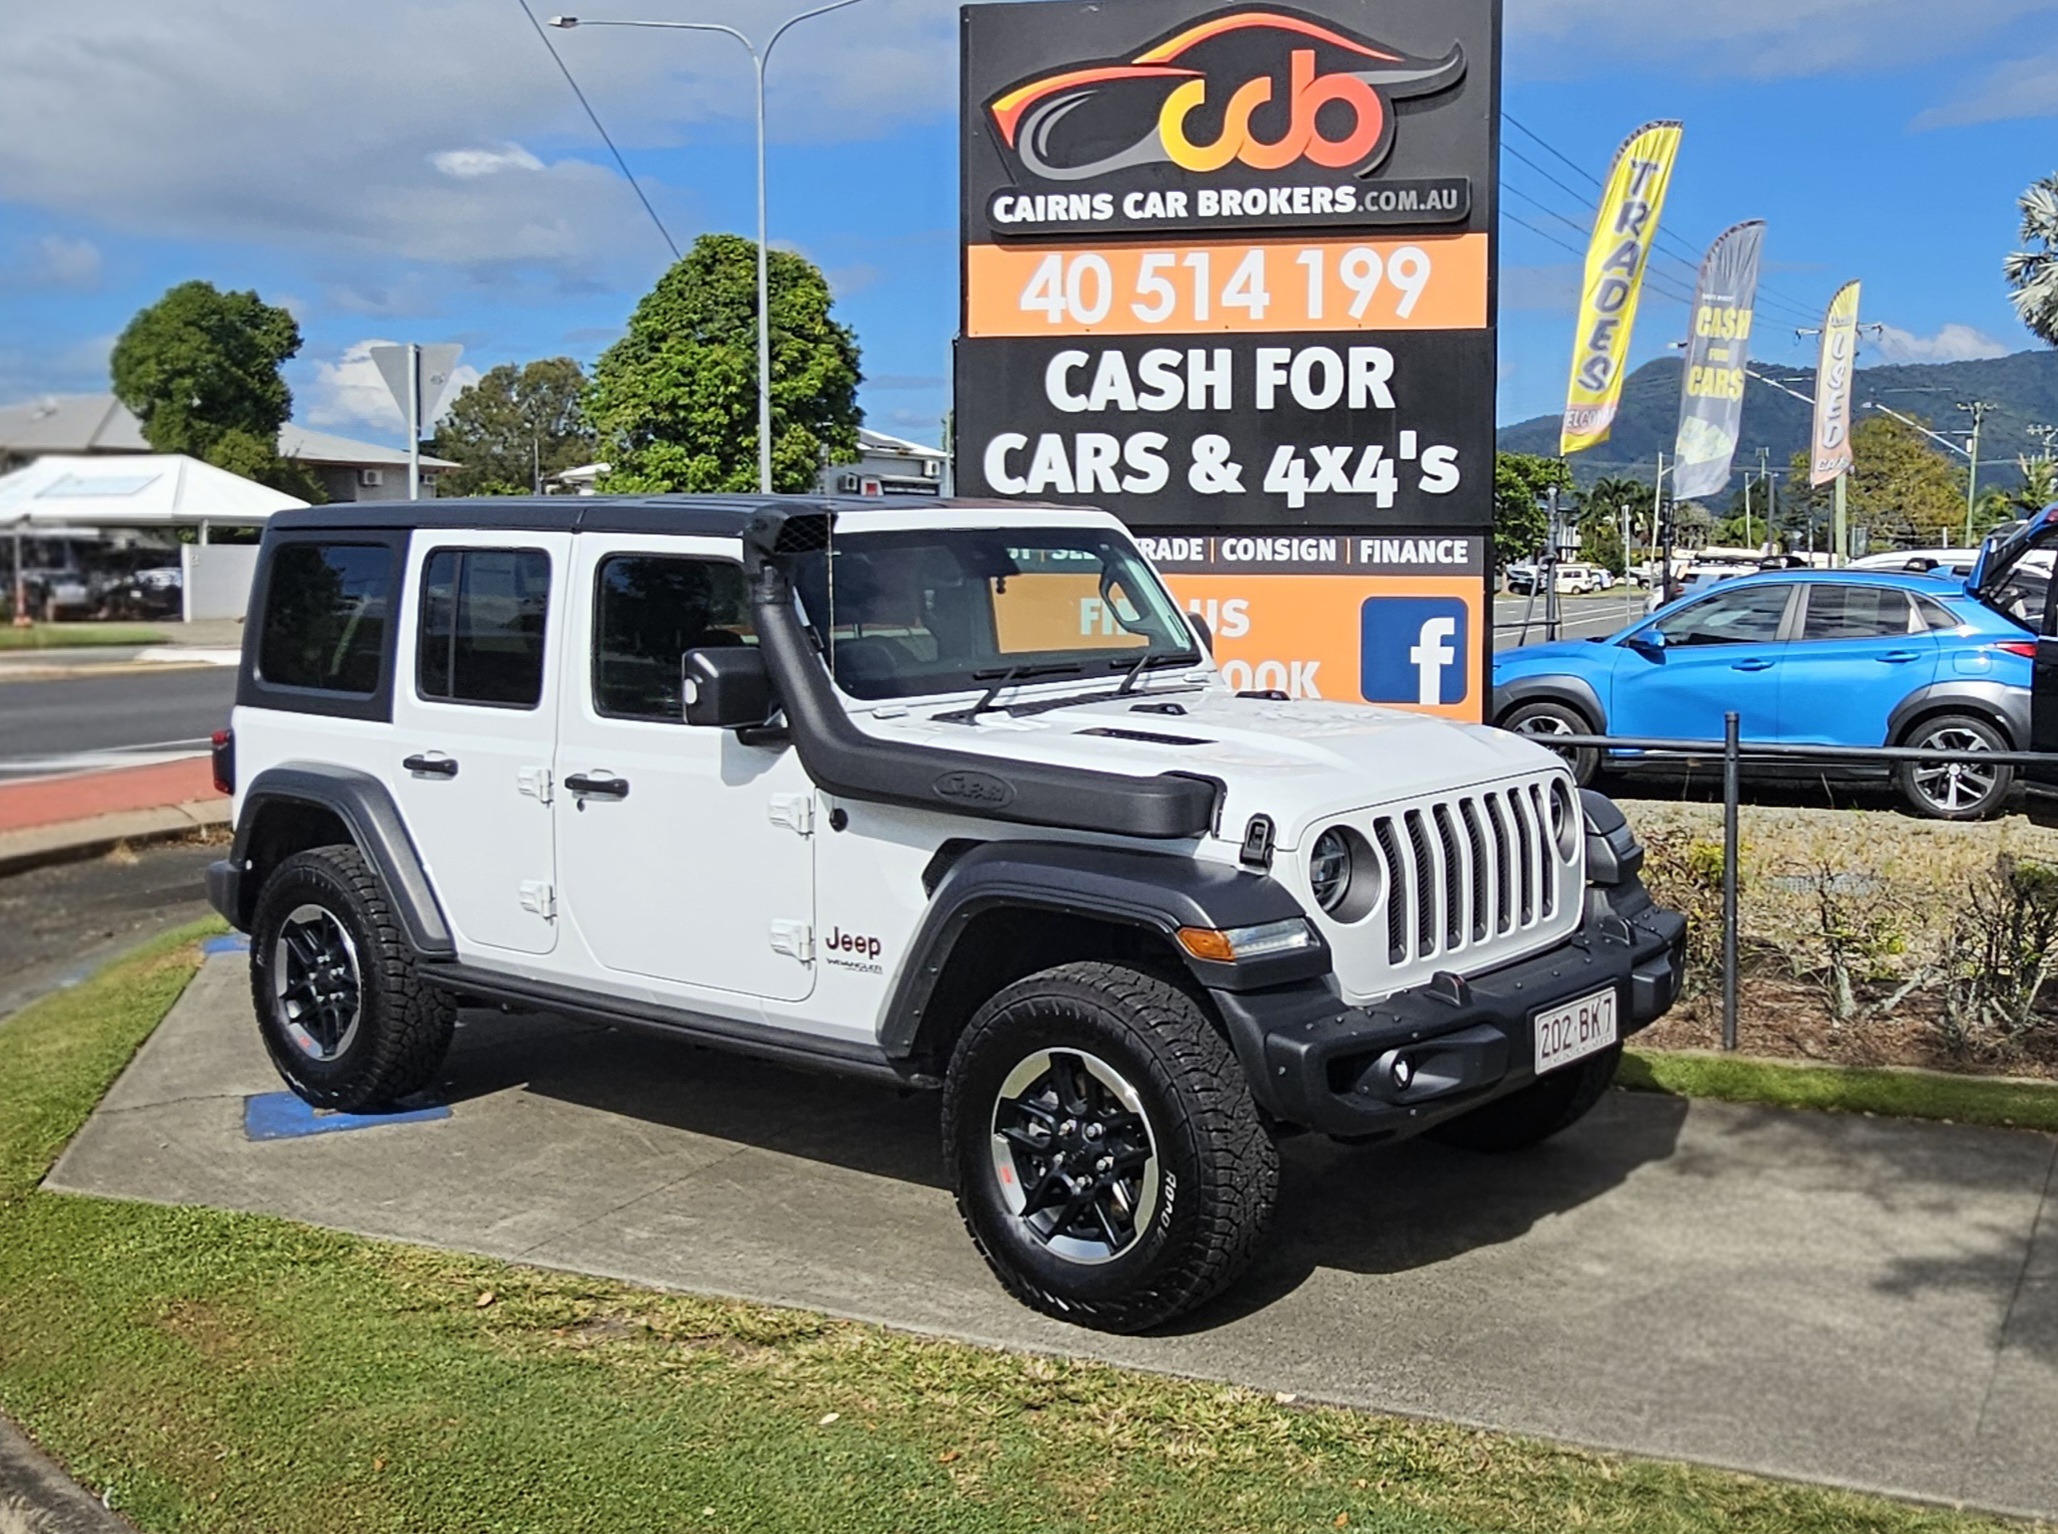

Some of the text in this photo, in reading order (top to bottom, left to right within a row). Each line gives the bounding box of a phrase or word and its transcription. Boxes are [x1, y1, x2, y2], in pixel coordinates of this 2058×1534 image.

[993, 193, 1114, 223] CAIRNS
[1123, 191, 1188, 219] CAR
[1020, 246, 1431, 323] 40 514 199
[1577, 159, 1659, 392] TRADES
[1045, 346, 1395, 412] CASH FOR
[984, 432, 1169, 494] CARS
[1188, 434, 1246, 493] &
[1222, 538, 1336, 562] CONSIGN
[1360, 540, 1468, 563] FINANCE
[825, 925, 881, 960] Jeep
